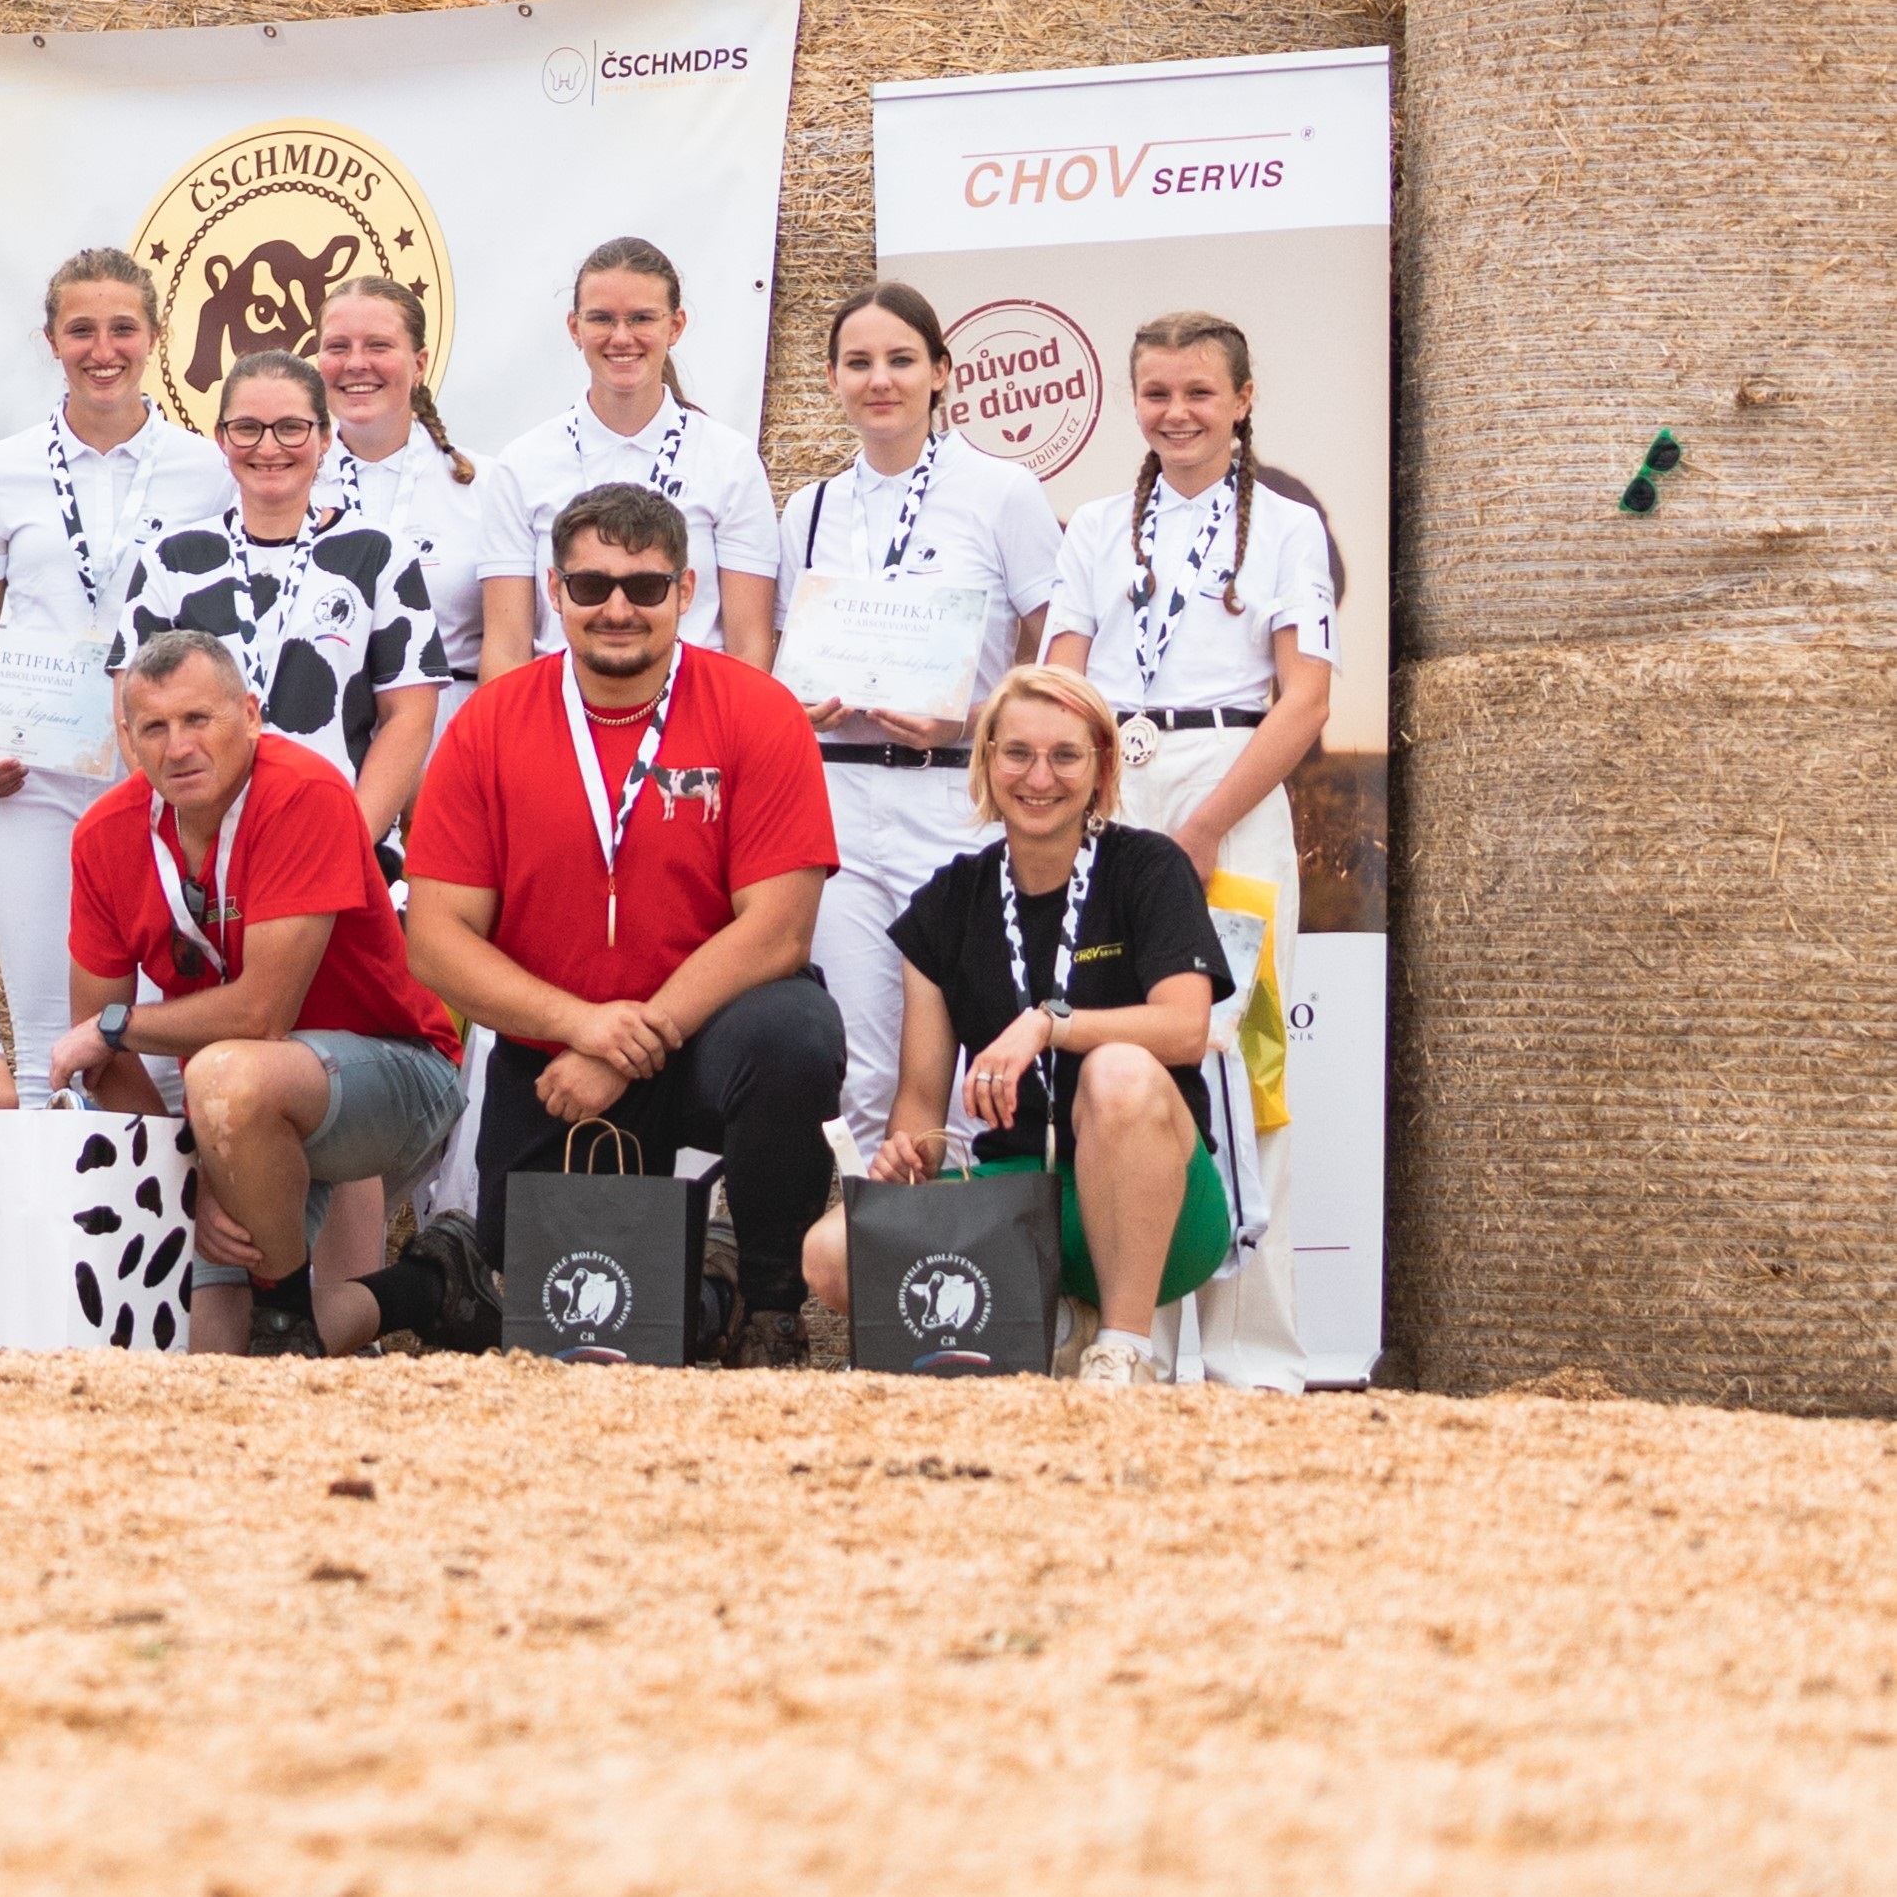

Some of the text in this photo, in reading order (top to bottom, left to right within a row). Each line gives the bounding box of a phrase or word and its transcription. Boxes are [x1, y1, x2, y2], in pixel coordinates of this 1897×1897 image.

[601, 47, 748, 79] ČSCHMDPS
[189, 144, 381, 212] ČSCHMDPS
[964, 143, 1284, 208] CHOV SERVIS
[955, 336, 1060, 393] původ
[980, 369, 1086, 419] důvod
[1074, 946, 1100, 963] CHOV
